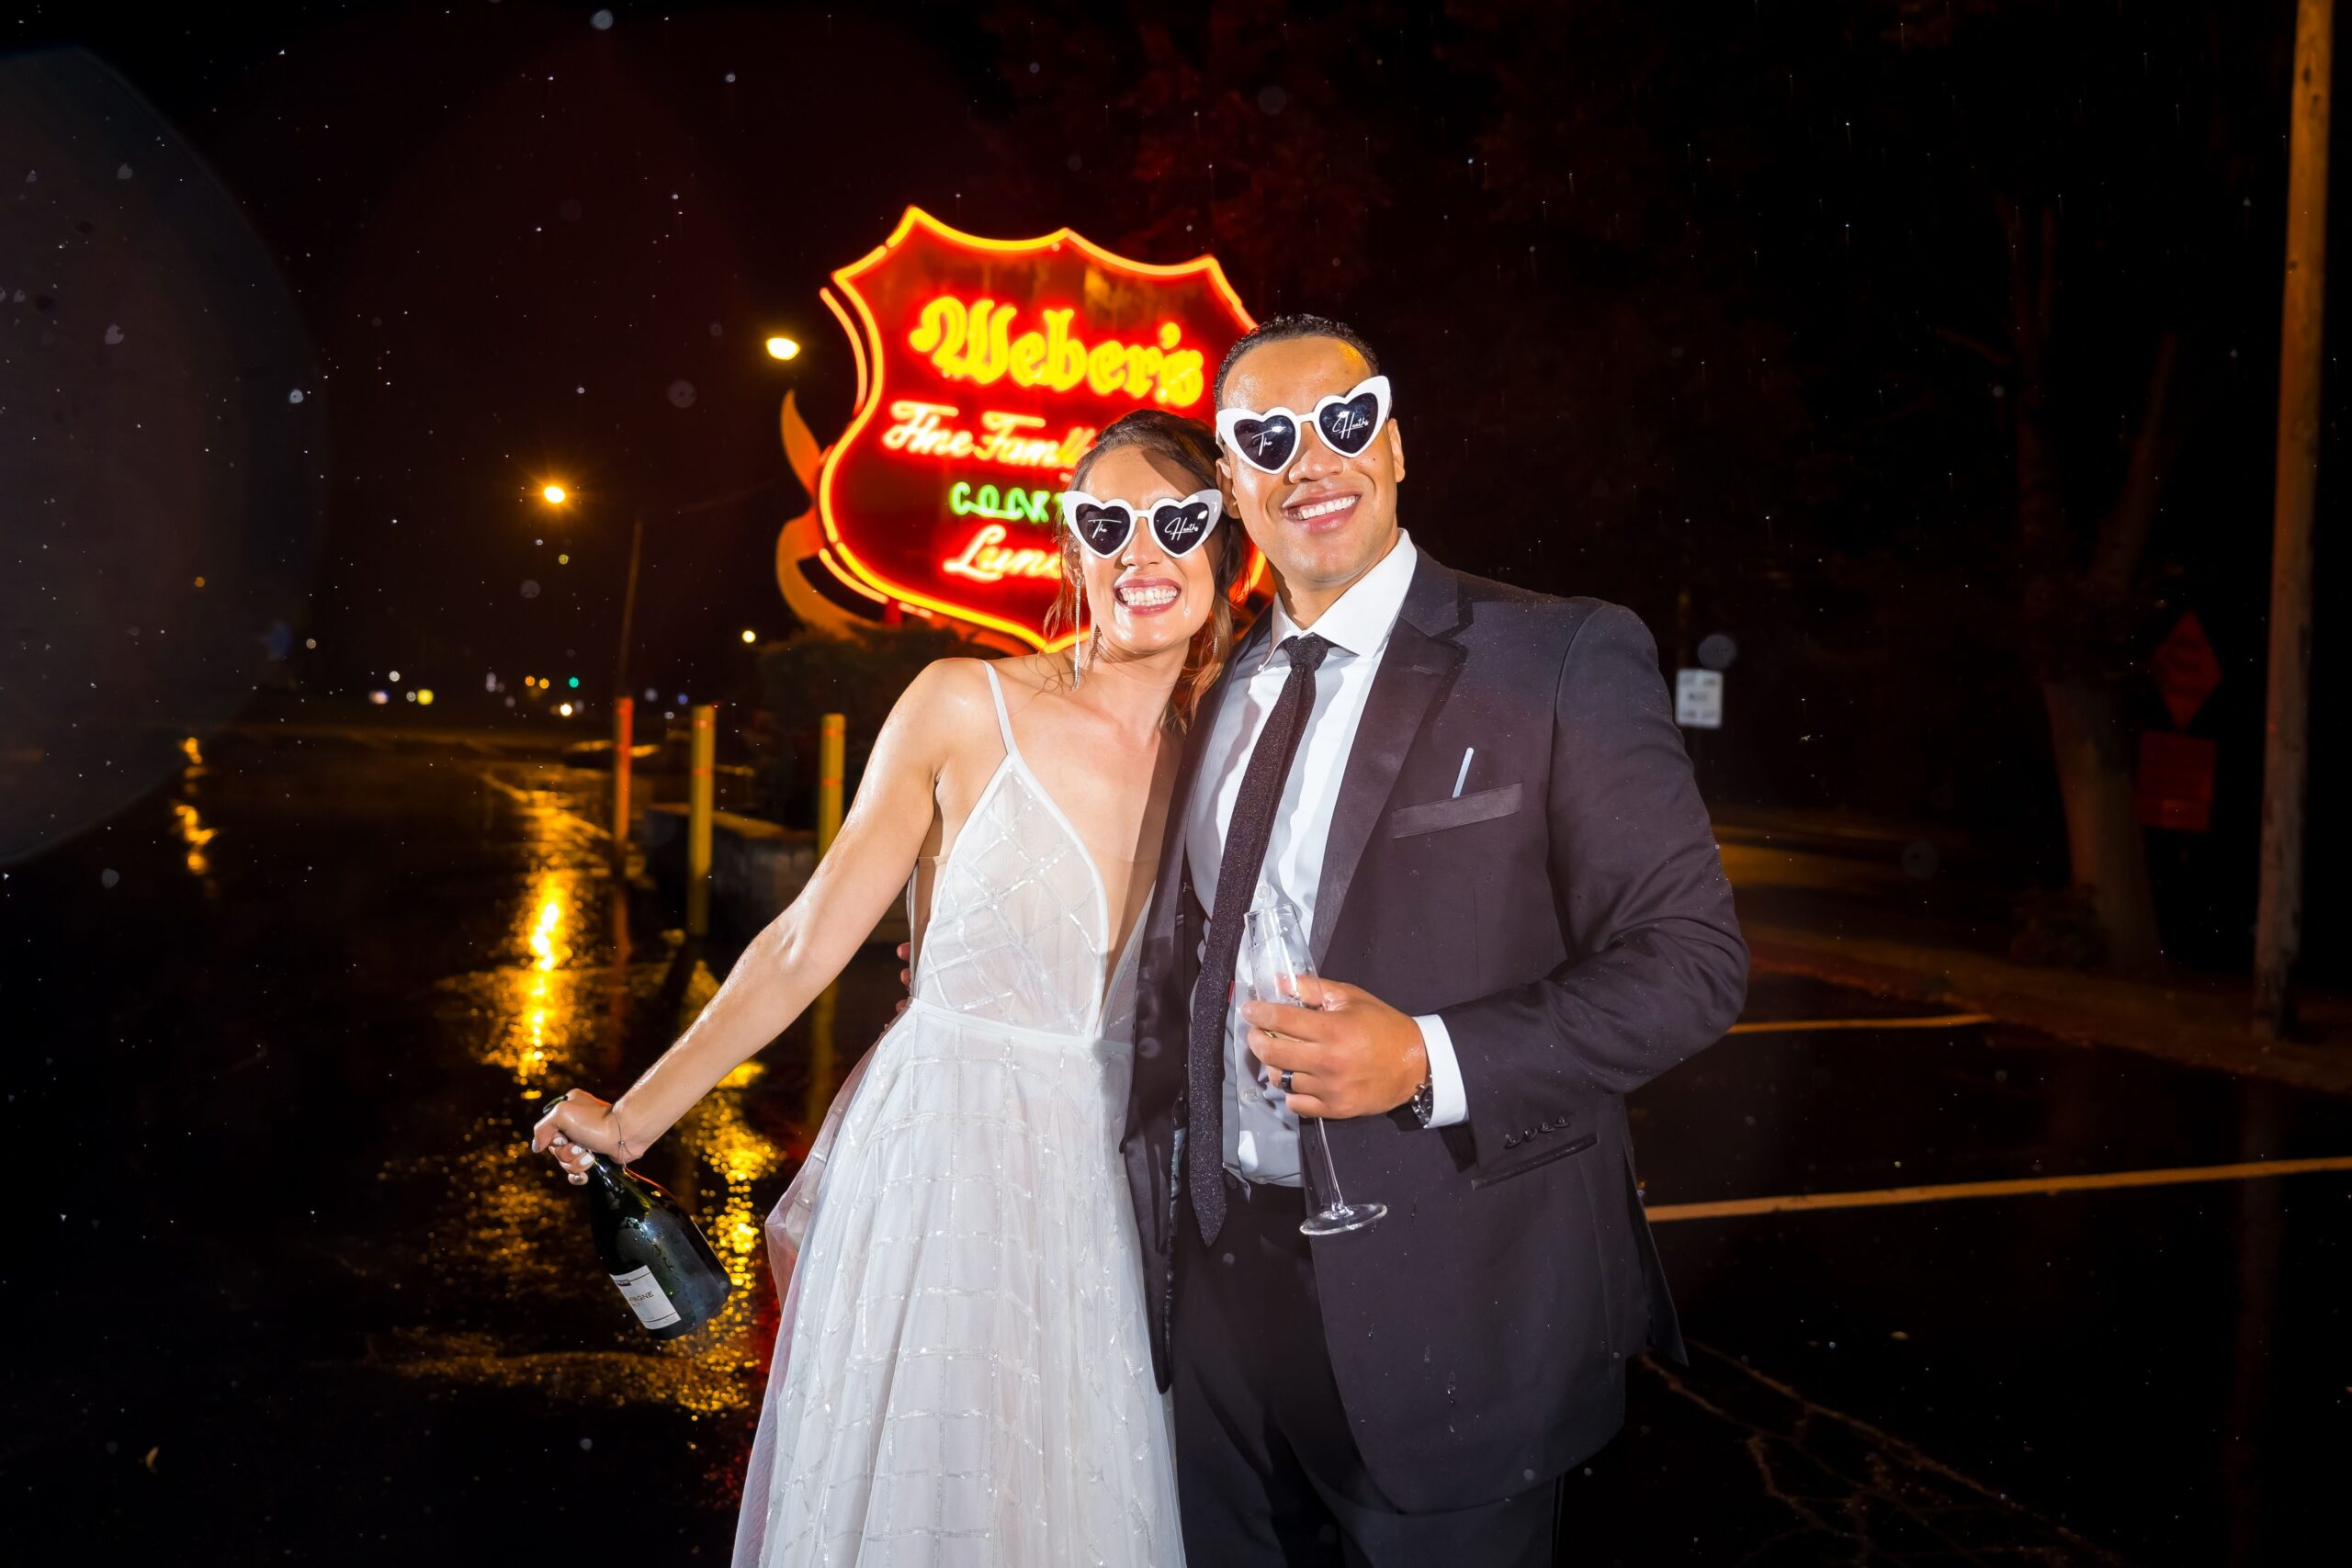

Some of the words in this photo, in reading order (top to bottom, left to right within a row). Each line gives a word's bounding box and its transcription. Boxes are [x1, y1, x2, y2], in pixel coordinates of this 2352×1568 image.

[909, 295, 1204, 407] Weber's
[882, 399, 975, 458] Fine
[1250, 424, 1286, 457] The
[949, 480, 1065, 524] COCK
[1087, 518, 1123, 539] The
